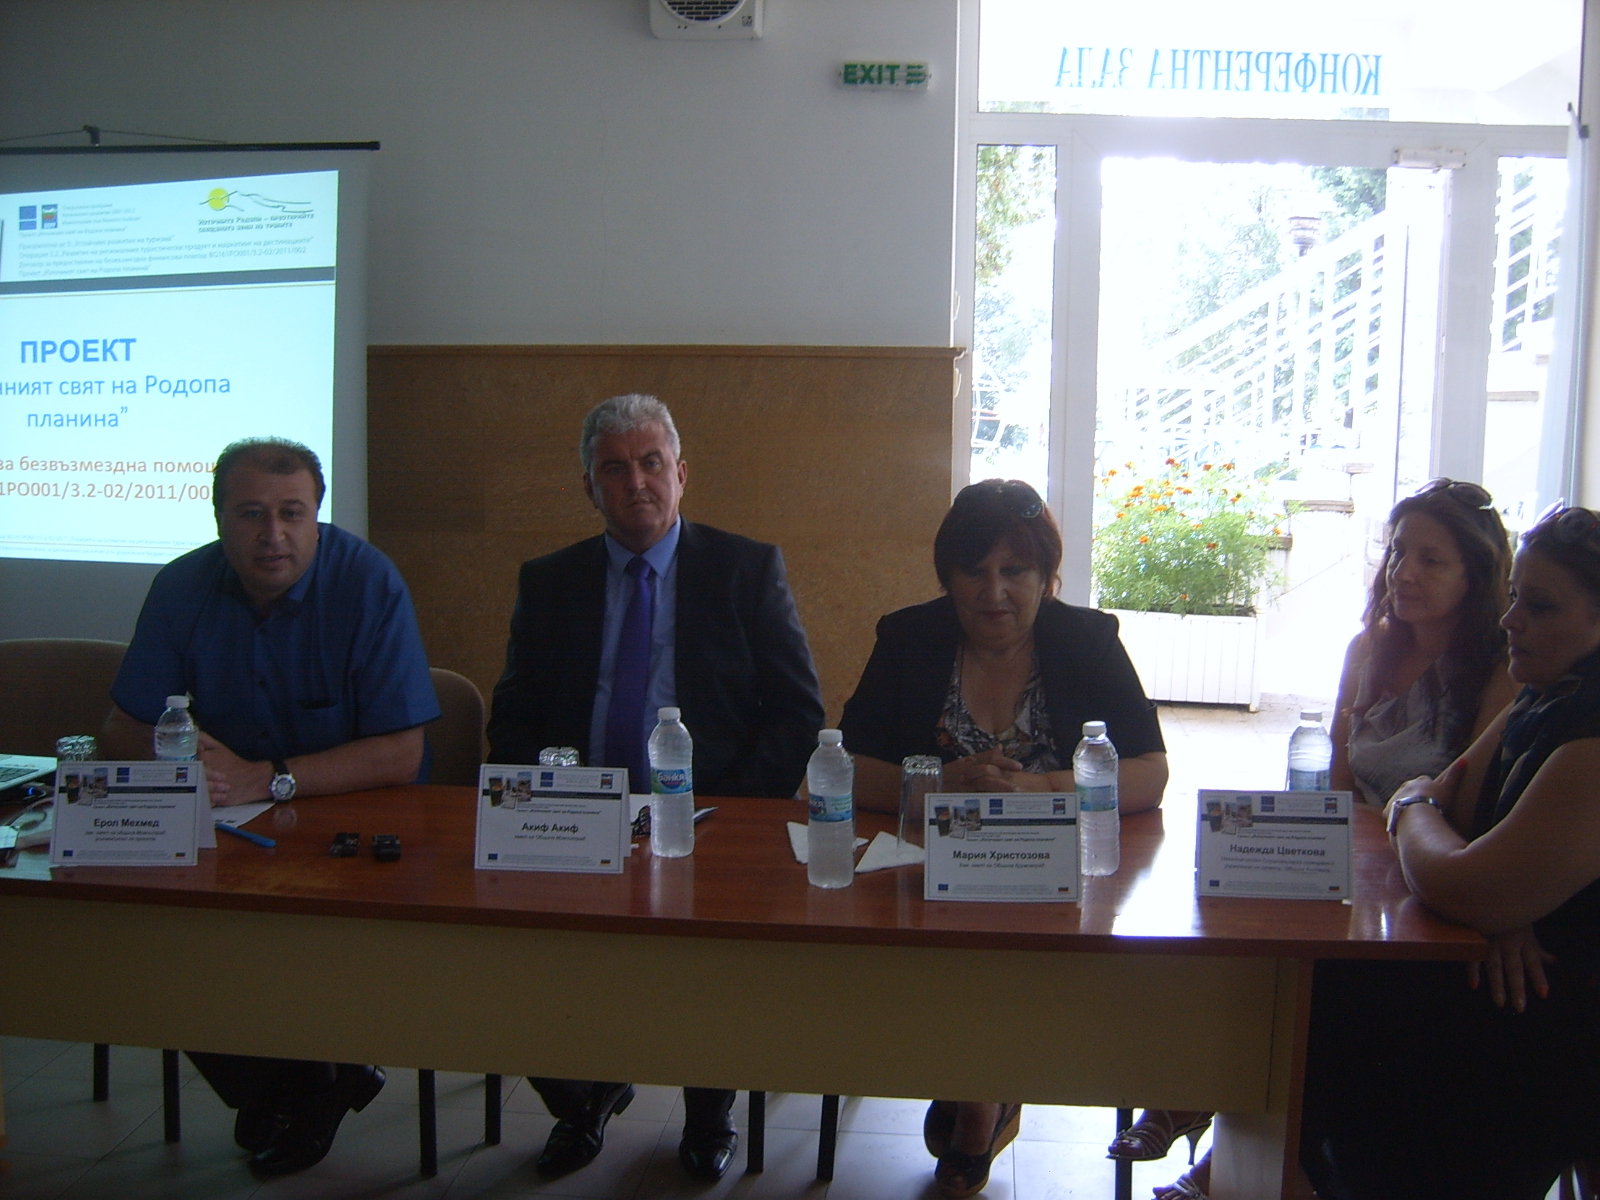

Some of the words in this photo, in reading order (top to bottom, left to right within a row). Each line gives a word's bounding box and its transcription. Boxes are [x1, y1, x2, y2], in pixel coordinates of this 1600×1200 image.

[843, 63, 899, 85] EXIT
[21, 338, 137, 363] ПРОЕКТ
[59, 380, 105, 395] свят
[112, 380, 137, 395] на
[145, 375, 231, 398] Родопа
[19, 455, 147, 475] безвъзмездна
[93, 817, 118, 829] Ерол
[121, 817, 160, 828] Мехмед
[521, 822, 548, 834] Акиф
[550, 823, 579, 835] Акиф
[952, 850, 987, 861] Мария
[989, 850, 1051, 862] Христозова
[1229, 843, 1275, 856] Надежда
[1277, 845, 1326, 857] Цветкова
